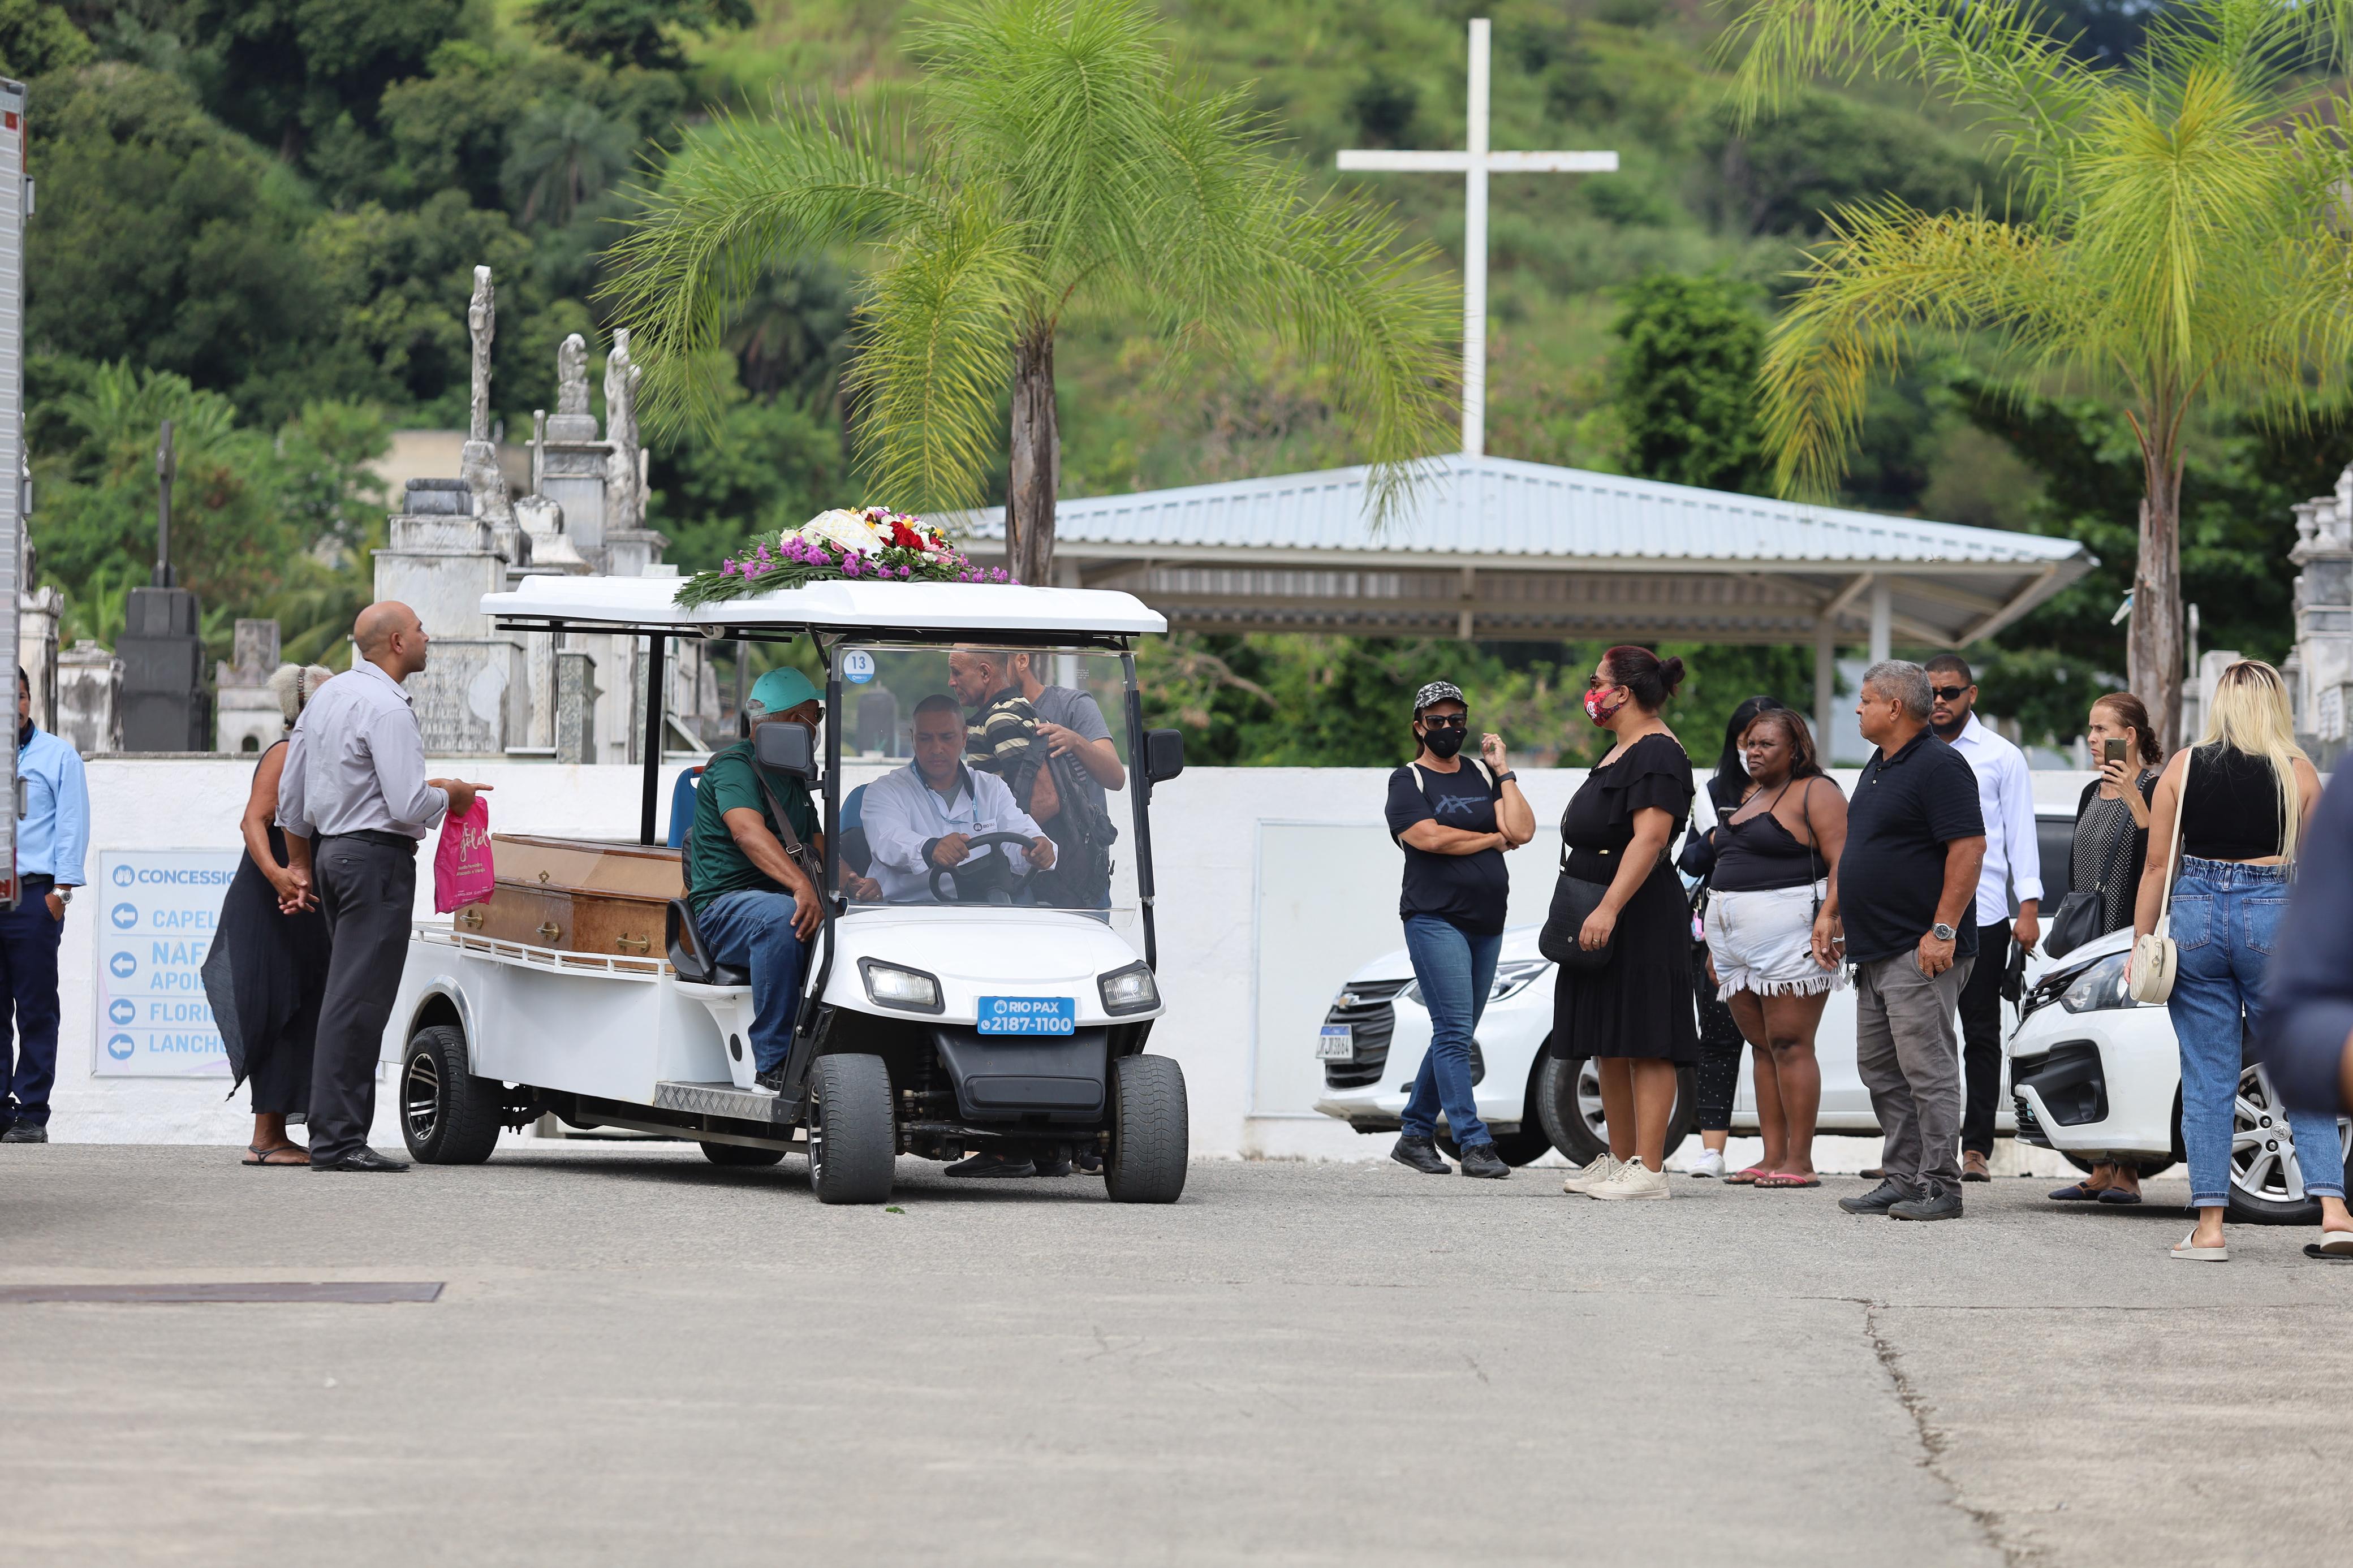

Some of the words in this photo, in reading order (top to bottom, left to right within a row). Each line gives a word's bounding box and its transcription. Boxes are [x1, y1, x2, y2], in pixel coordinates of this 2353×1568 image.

[852, 656, 866, 669] 13
[153, 910, 218, 928] CAPEL
[152, 941, 206, 965] NAF
[150, 971, 205, 990] APOI
[150, 1003, 215, 1022] FLORI
[1009, 1001, 1031, 1013] RIO
[1033, 1002, 1059, 1013] PAX
[991, 1017, 1072, 1033] 2187-1100
